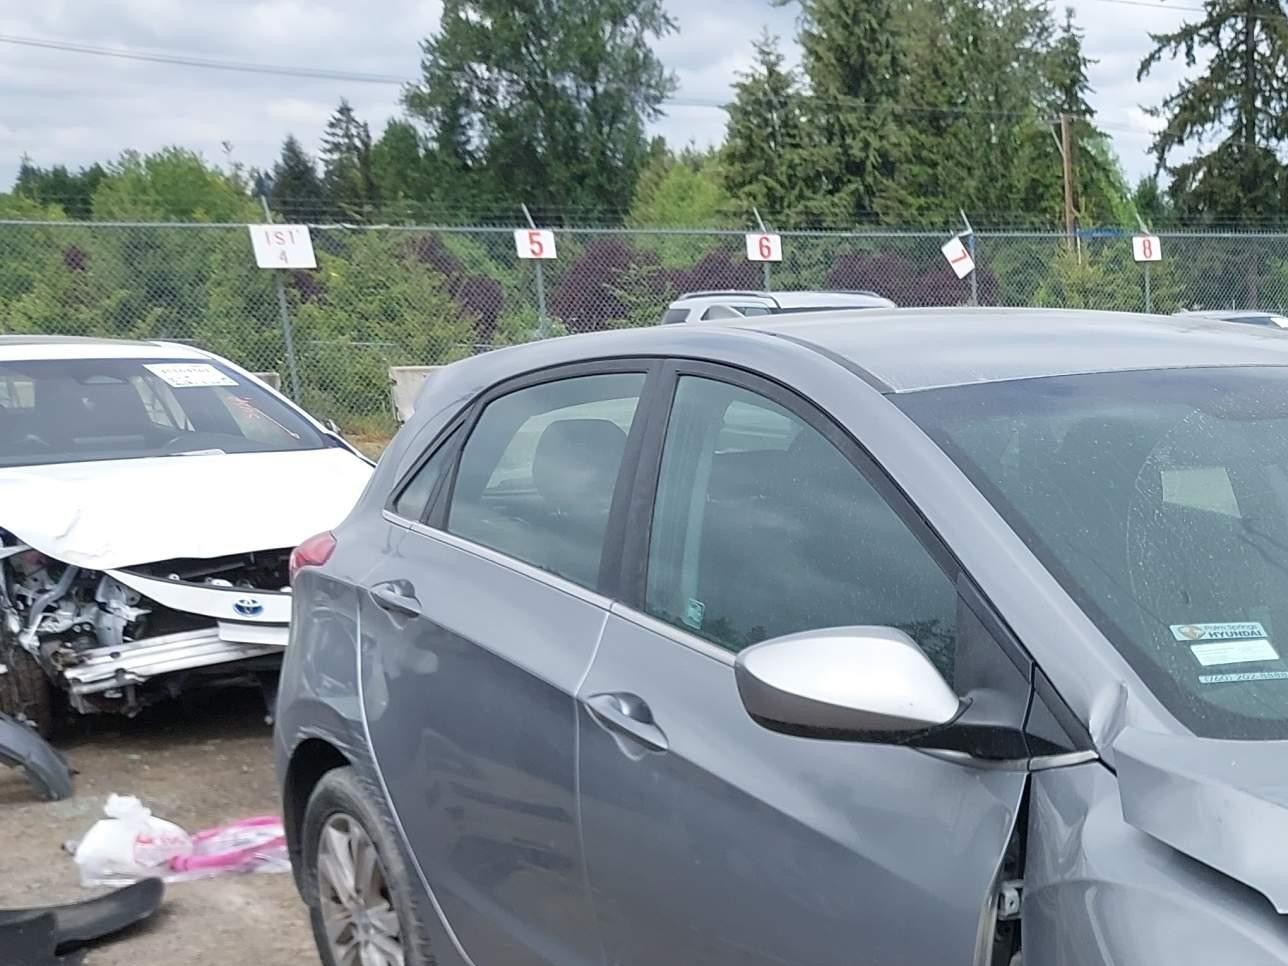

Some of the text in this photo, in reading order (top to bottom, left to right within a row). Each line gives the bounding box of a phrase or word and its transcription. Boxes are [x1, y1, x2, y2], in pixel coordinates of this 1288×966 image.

[528, 231, 544, 256] 5
[758, 236, 771, 259] 6
[1142, 239, 1153, 259] 8
[951, 248, 968, 264] 7
[1208, 630, 1262, 638] HYUNDAI
